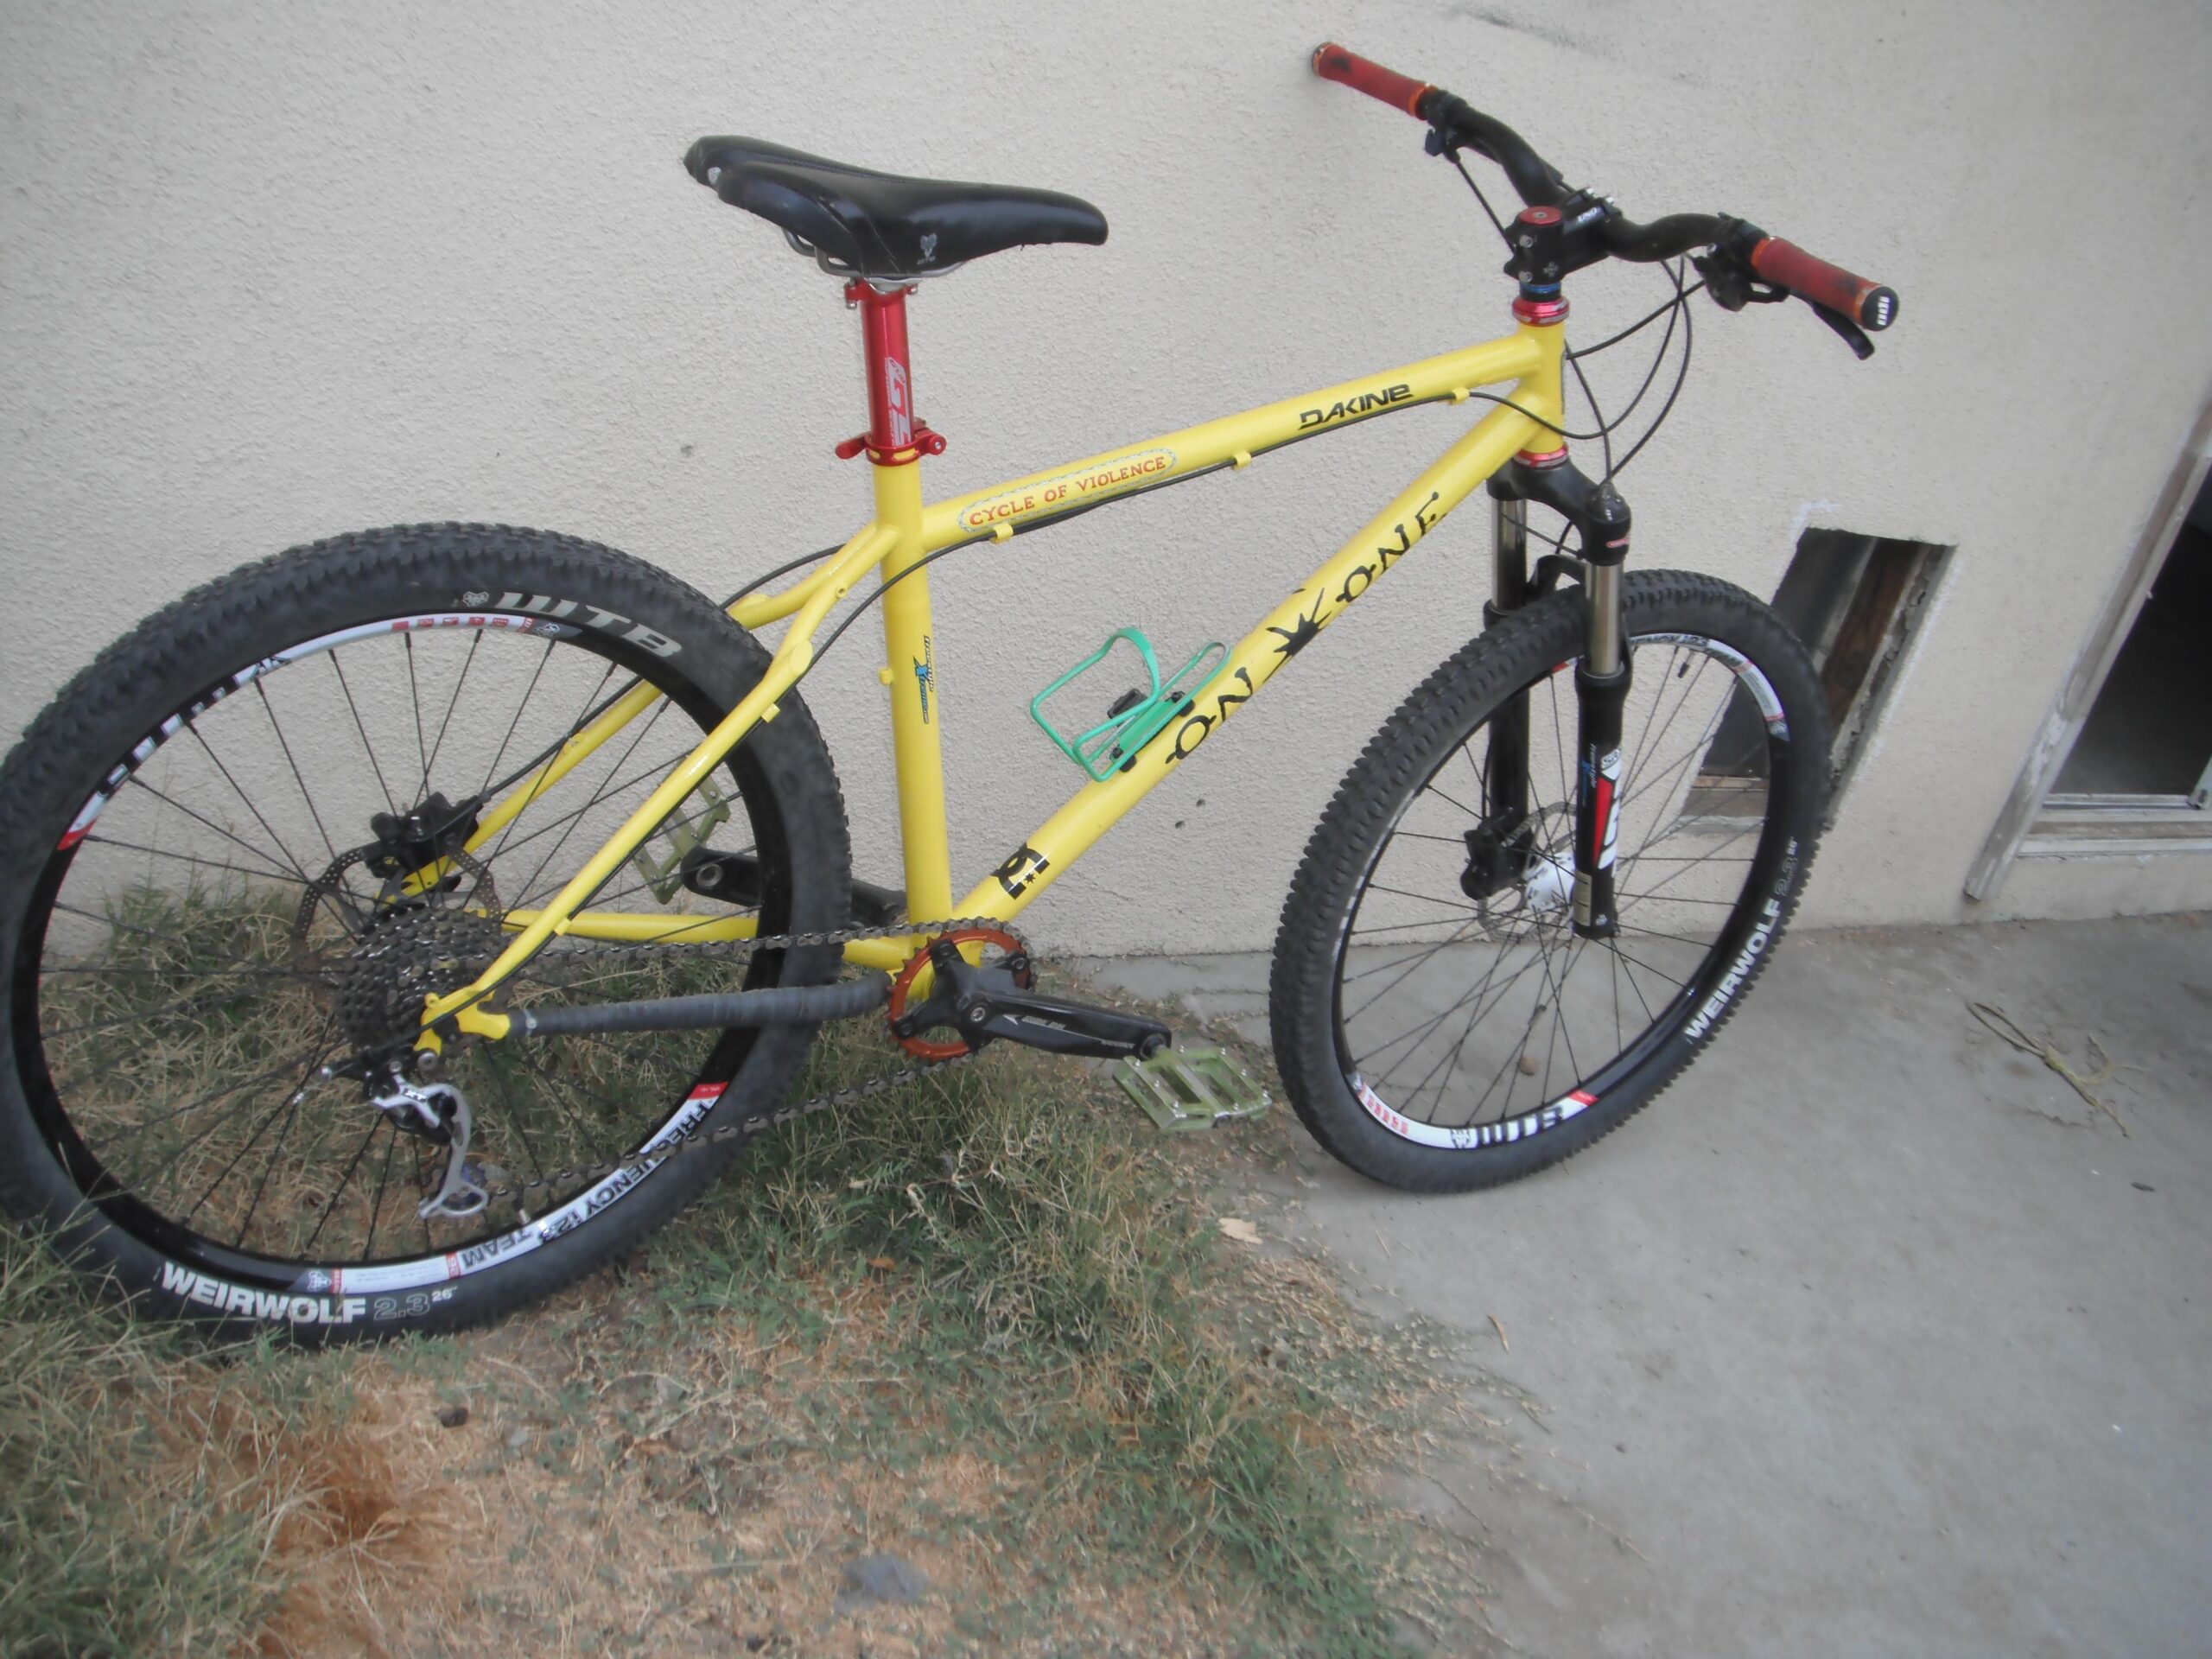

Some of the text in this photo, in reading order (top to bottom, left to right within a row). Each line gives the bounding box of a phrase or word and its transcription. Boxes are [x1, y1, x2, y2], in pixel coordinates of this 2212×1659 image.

[1298, 384, 1414, 430] DAKINE
[969, 456, 1166, 525] CYCLE OF VIOLENCE
[1684, 898, 1781, 1039] WEIRWOLF
[461, 1228, 534, 1269] TEAM
[162, 1261, 366, 1324] WEIRWOLF
[373, 1293, 430, 1321] 2.3
